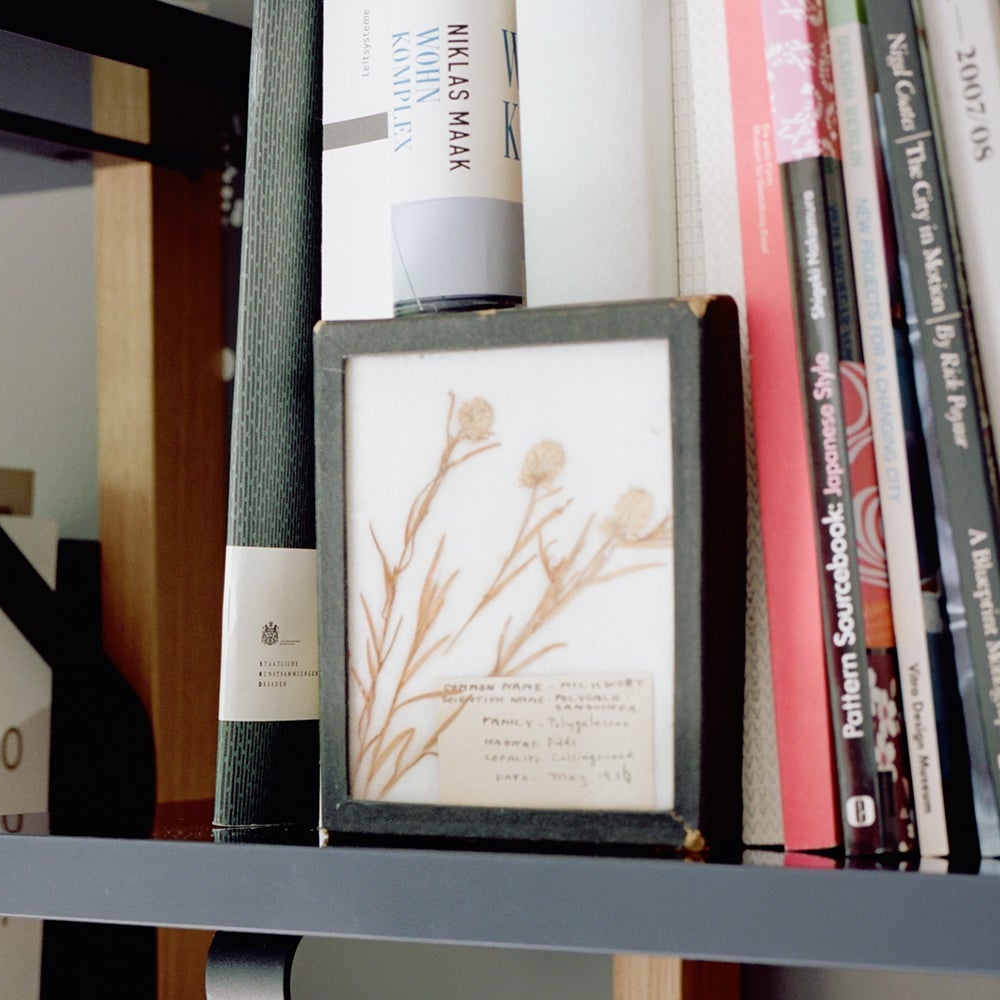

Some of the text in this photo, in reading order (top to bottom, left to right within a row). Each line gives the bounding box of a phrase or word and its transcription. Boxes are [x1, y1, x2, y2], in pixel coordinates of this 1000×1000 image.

[392, 31, 412, 152] KOMPLEX
[415, 27, 440, 104] WOHN
[447, 24, 471, 171] NIKLAS MAAK
[957, 47, 992, 162] 2007/08
[910, 180, 933, 221] City
[918, 224, 938, 246] in
[922, 246, 949, 314] Motion
[932, 324, 956, 349] By
[810, 352, 865, 739] Pattern Sourcebook: Japanese Style
[967, 528, 988, 546] A
[971, 548, 998, 636] Blueprint
[911, 702, 925, 750] Design
